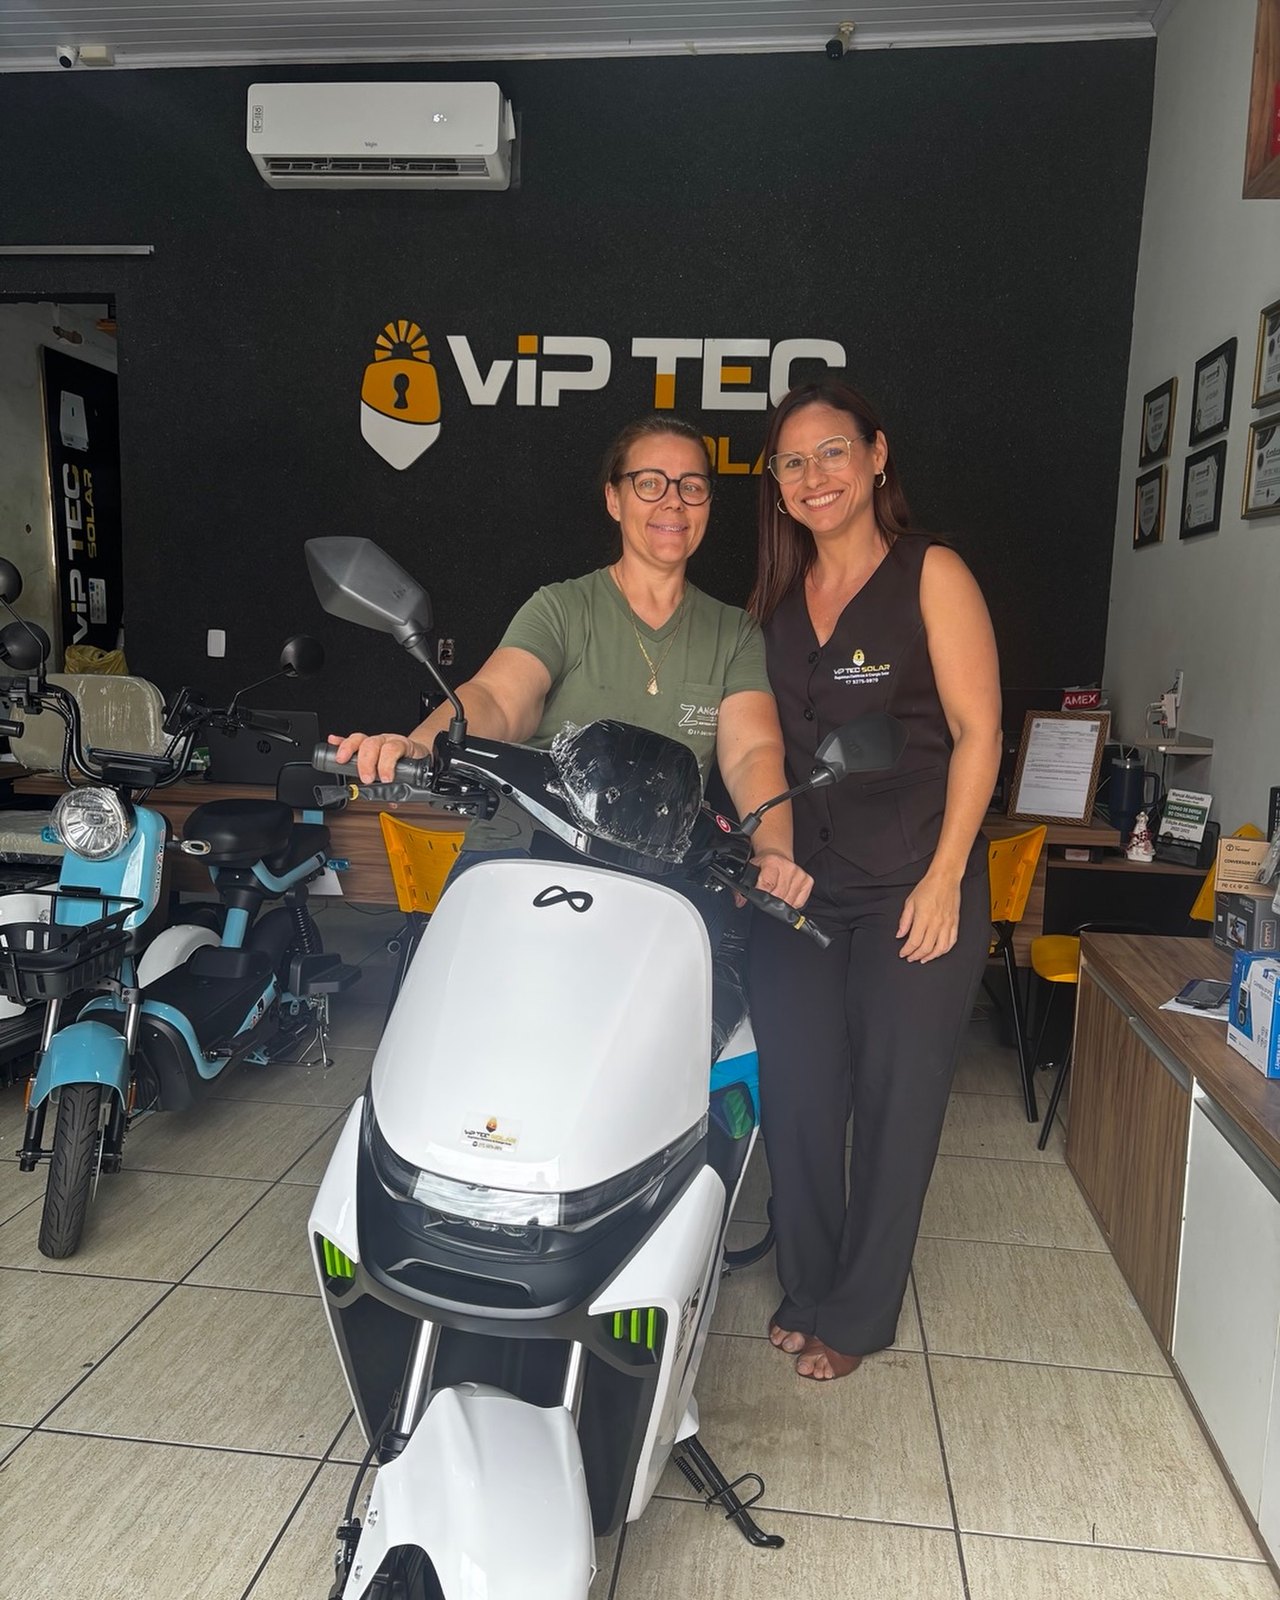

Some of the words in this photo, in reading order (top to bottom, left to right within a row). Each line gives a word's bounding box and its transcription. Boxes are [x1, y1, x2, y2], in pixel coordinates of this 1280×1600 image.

[631, 337, 847, 411] TEC
[62, 463, 84, 561] TEC
[83, 468, 97, 559] SOLAR
[861, 664, 891, 673] SOLAR
[1064, 694, 1097, 706] AMEX
[1224, 858, 1251, 866] CONVERSOR
